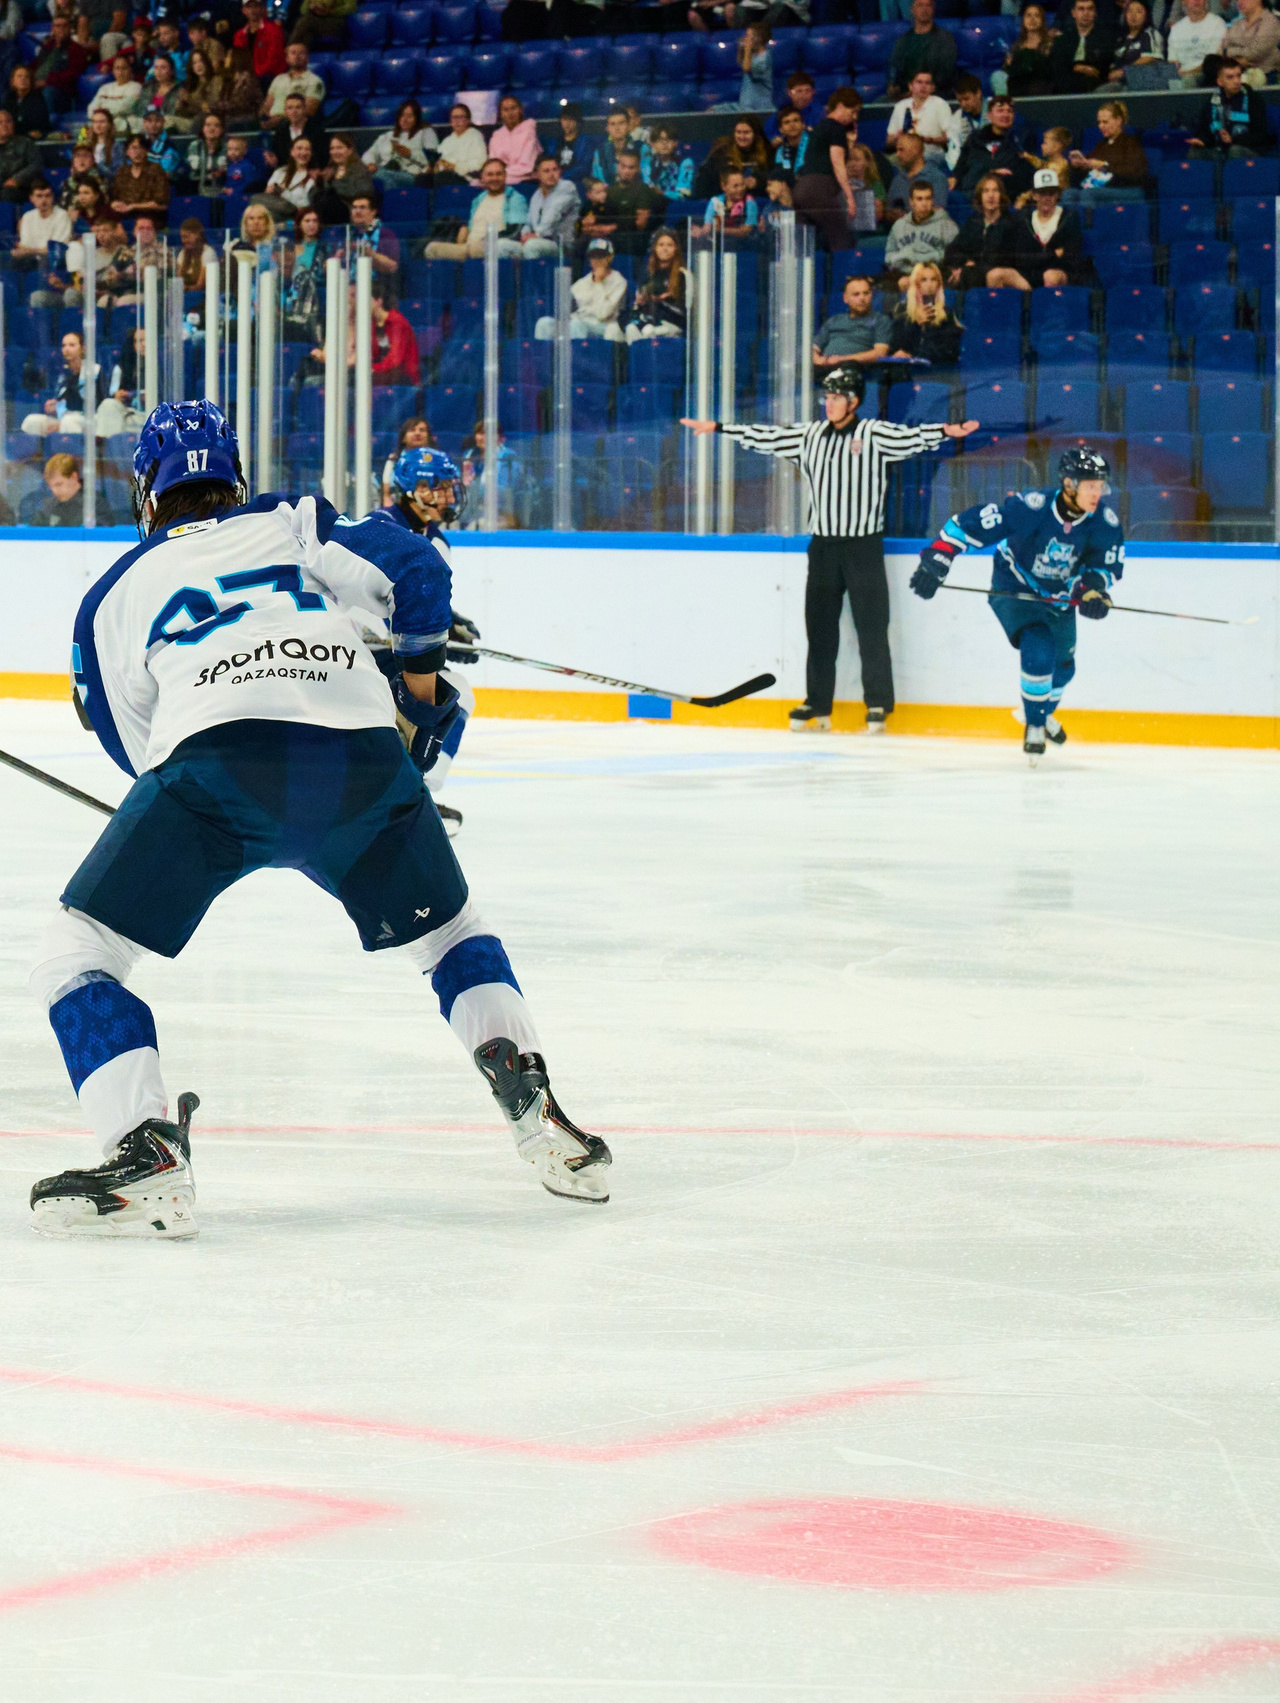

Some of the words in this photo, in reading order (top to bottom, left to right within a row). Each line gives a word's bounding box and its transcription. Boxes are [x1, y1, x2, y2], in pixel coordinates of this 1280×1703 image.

[186, 448, 209, 472] 87
[979, 503, 1003, 530] 66
[231, 667, 328, 685] QAZAQSTAN
